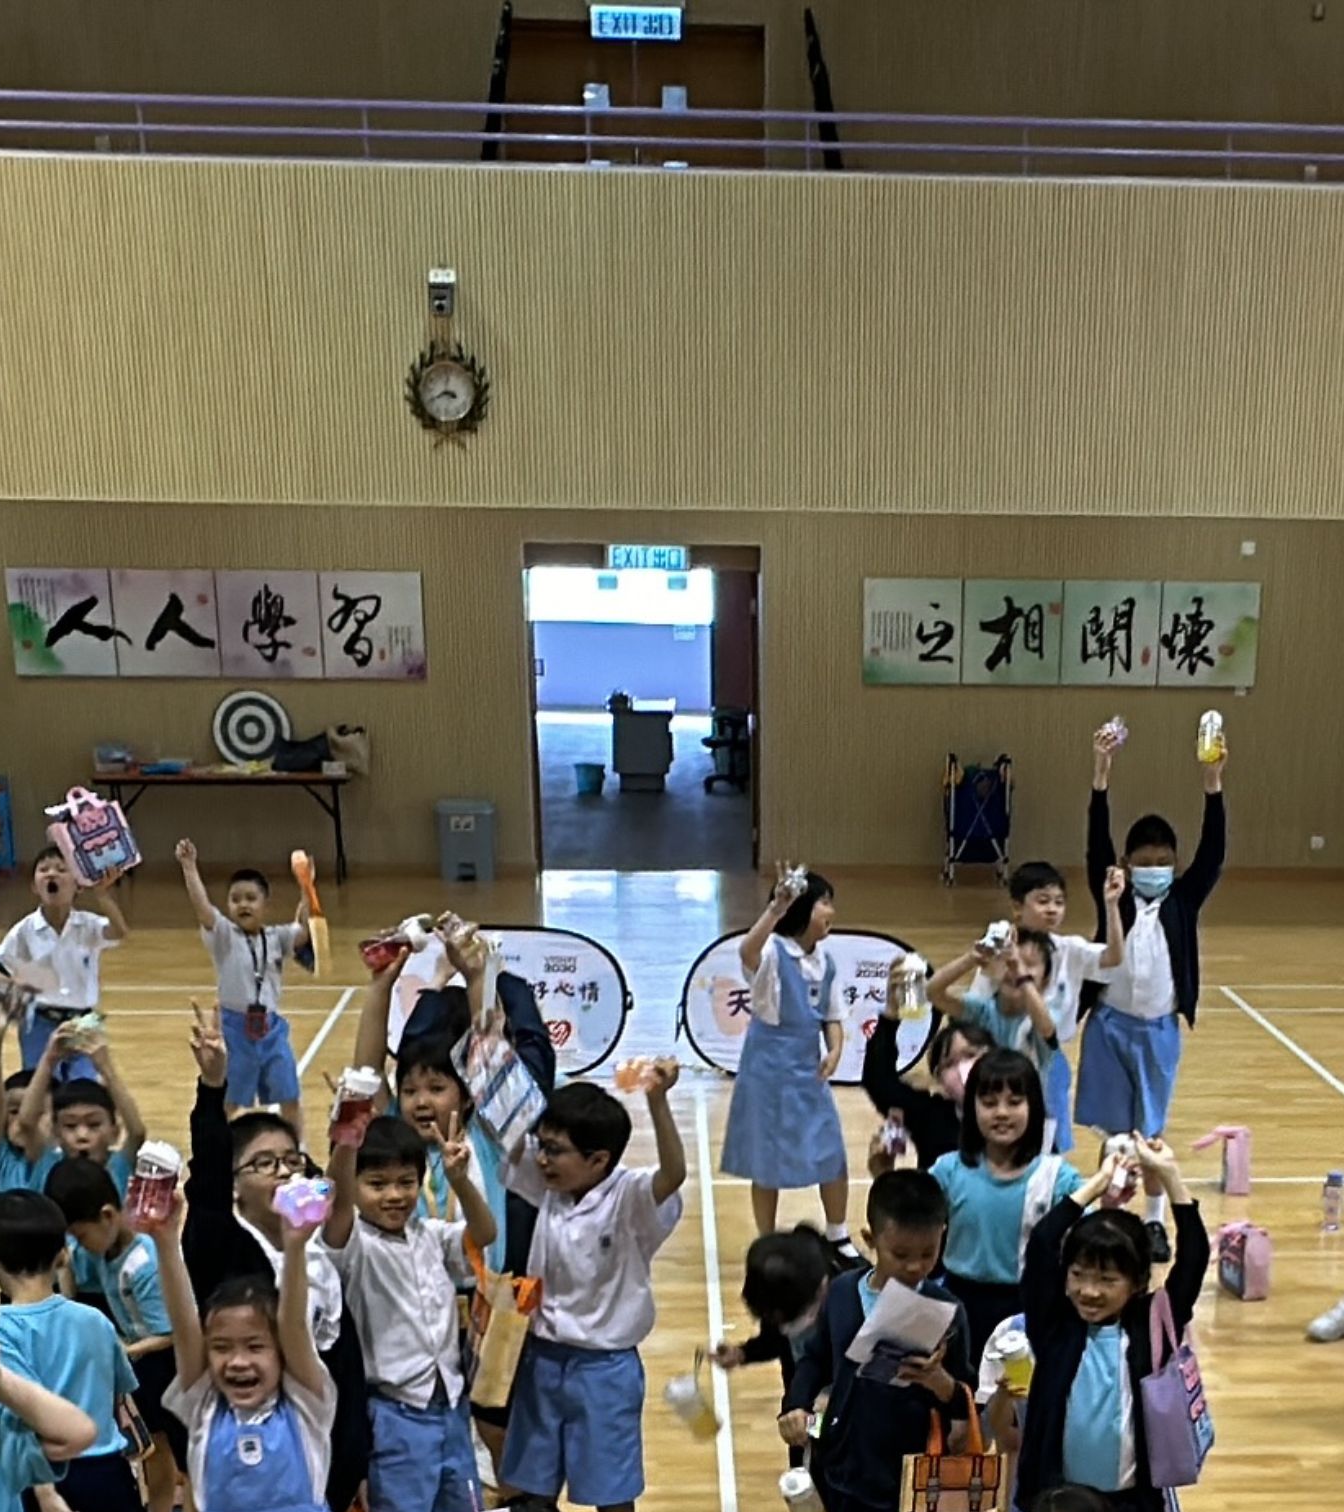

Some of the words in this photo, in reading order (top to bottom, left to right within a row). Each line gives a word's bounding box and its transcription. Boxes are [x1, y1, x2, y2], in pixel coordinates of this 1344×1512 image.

[598, 12, 637, 34] EXIT
[612, 547, 650, 568] EXIT
[653, 548, 682, 569] 出口
